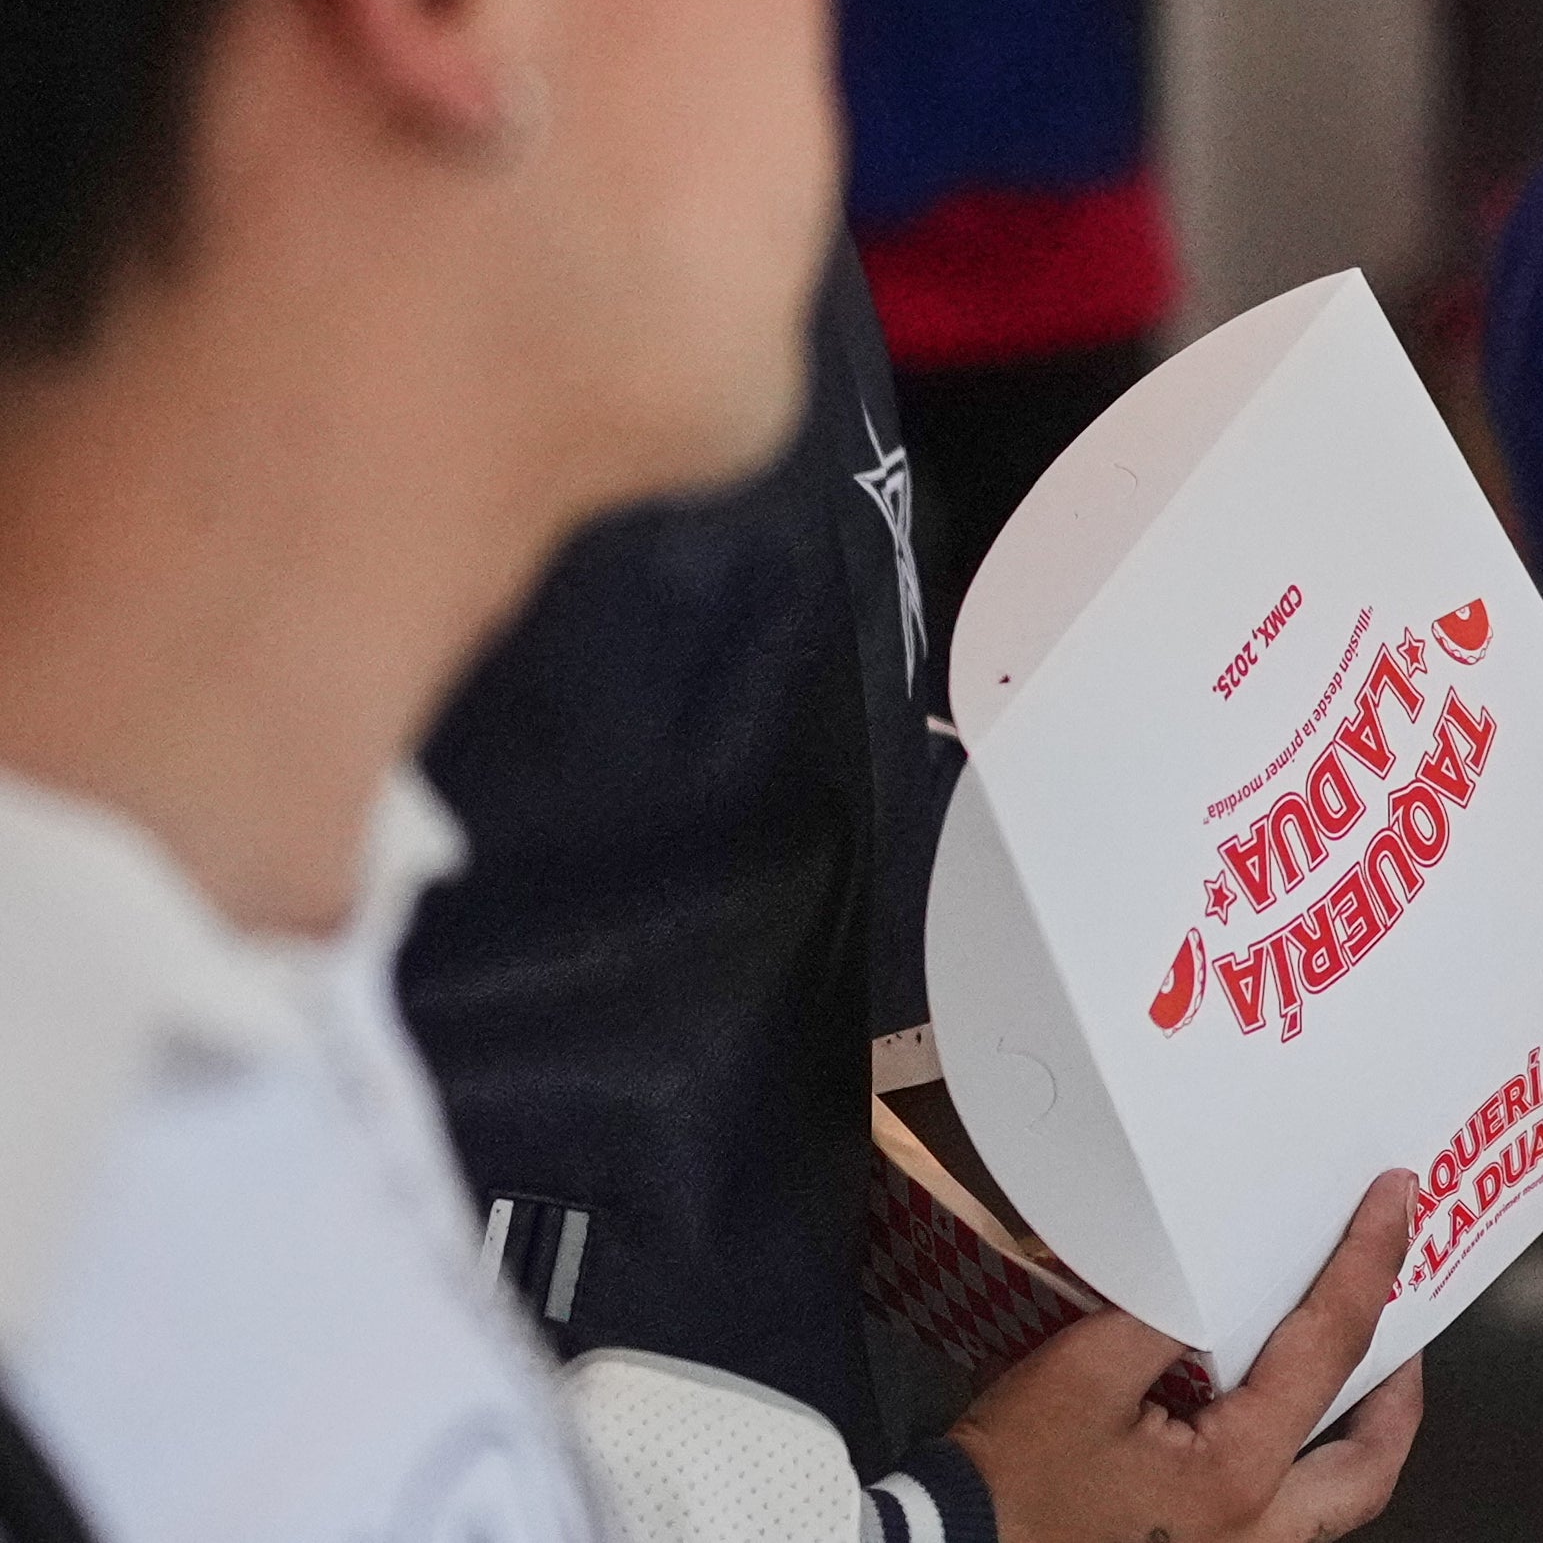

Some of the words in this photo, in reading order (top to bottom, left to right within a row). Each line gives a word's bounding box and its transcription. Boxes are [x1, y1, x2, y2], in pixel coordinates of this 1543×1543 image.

[1251, 584, 1303, 649] CDMX,
[1212, 641, 1259, 702] 2025.
[1312, 671, 1343, 723] desde
[1301, 717, 1317, 737] la
[1333, 642, 1425, 781] LA
[1265, 729, 1304, 788] primer
[1217, 741, 1367, 914] DUA
[1212, 685, 1498, 1043] TAQUERÍA
[1420, 1199, 1479, 1281] LA
